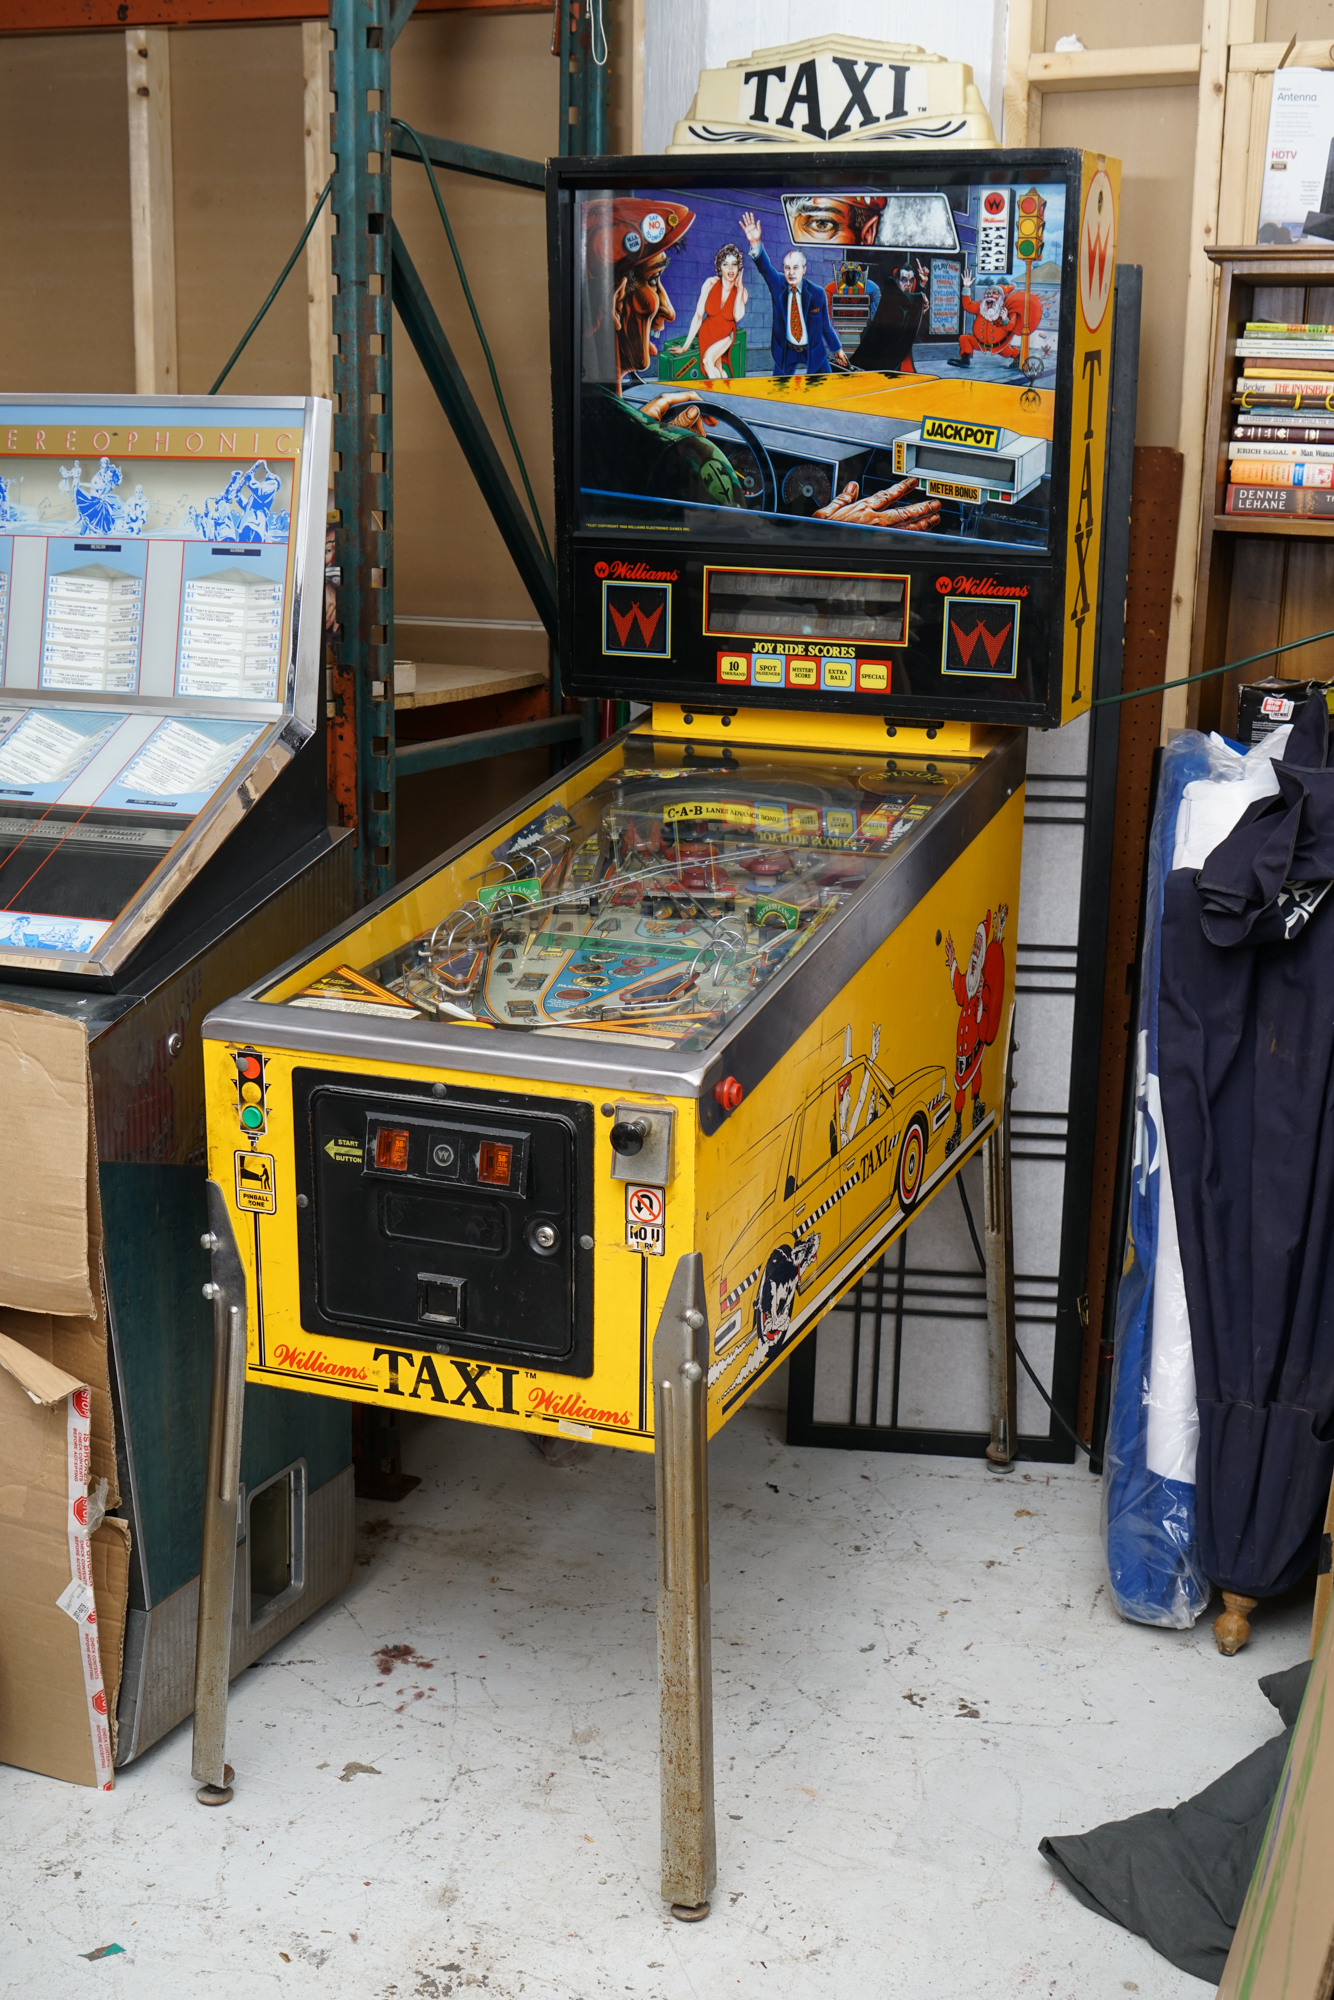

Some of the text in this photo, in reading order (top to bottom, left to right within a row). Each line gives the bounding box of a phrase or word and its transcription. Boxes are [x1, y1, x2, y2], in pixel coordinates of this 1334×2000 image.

[744, 56, 910, 141] TAXI
[1277, 92, 1317, 102] Antenna
[1271, 150, 1298, 160] HDTV
[648, 214, 660, 222] SAY
[648, 220, 661, 230] NO
[1243, 382, 1331, 396] Becker THE INVISIBLE
[926, 422, 994, 446] JACKPOT
[1263, 448, 1289, 456] SEGAL
[930, 482, 978, 500] METER BONUS
[1239, 489, 1287, 499] DENNIS
[1238, 499, 1286, 510] LEHANE
[1070, 349, 1101, 704] TAXI
[609, 560, 680, 582] Williams
[952, 575, 1030, 597] Williams
[752, 642, 856, 659] JOY RIDE SCORES
[728, 661, 739, 671] 10
[759, 664, 777, 672] SPOT
[868, 771, 949, 785] SPINOUT
[667, 806, 703, 819] C-A-B
[729, 809, 759, 820] ADVANCE
[512, 885, 532, 896] LANE
[529, 889, 540, 903] 2
[757, 903, 778, 919] EXPRESS
[777, 905, 790, 919] LANE
[338, 1139, 359, 1147] START
[335, 1155, 362, 1163] BUTTON
[860, 1135, 889, 1184] TAXI
[243, 1193, 270, 1202] PINBALL
[630, 1225, 660, 1242] NO U
[273, 1344, 369, 1381] Williams
[372, 1347, 520, 1416] TAXI
[528, 1387, 634, 1426] Williams
